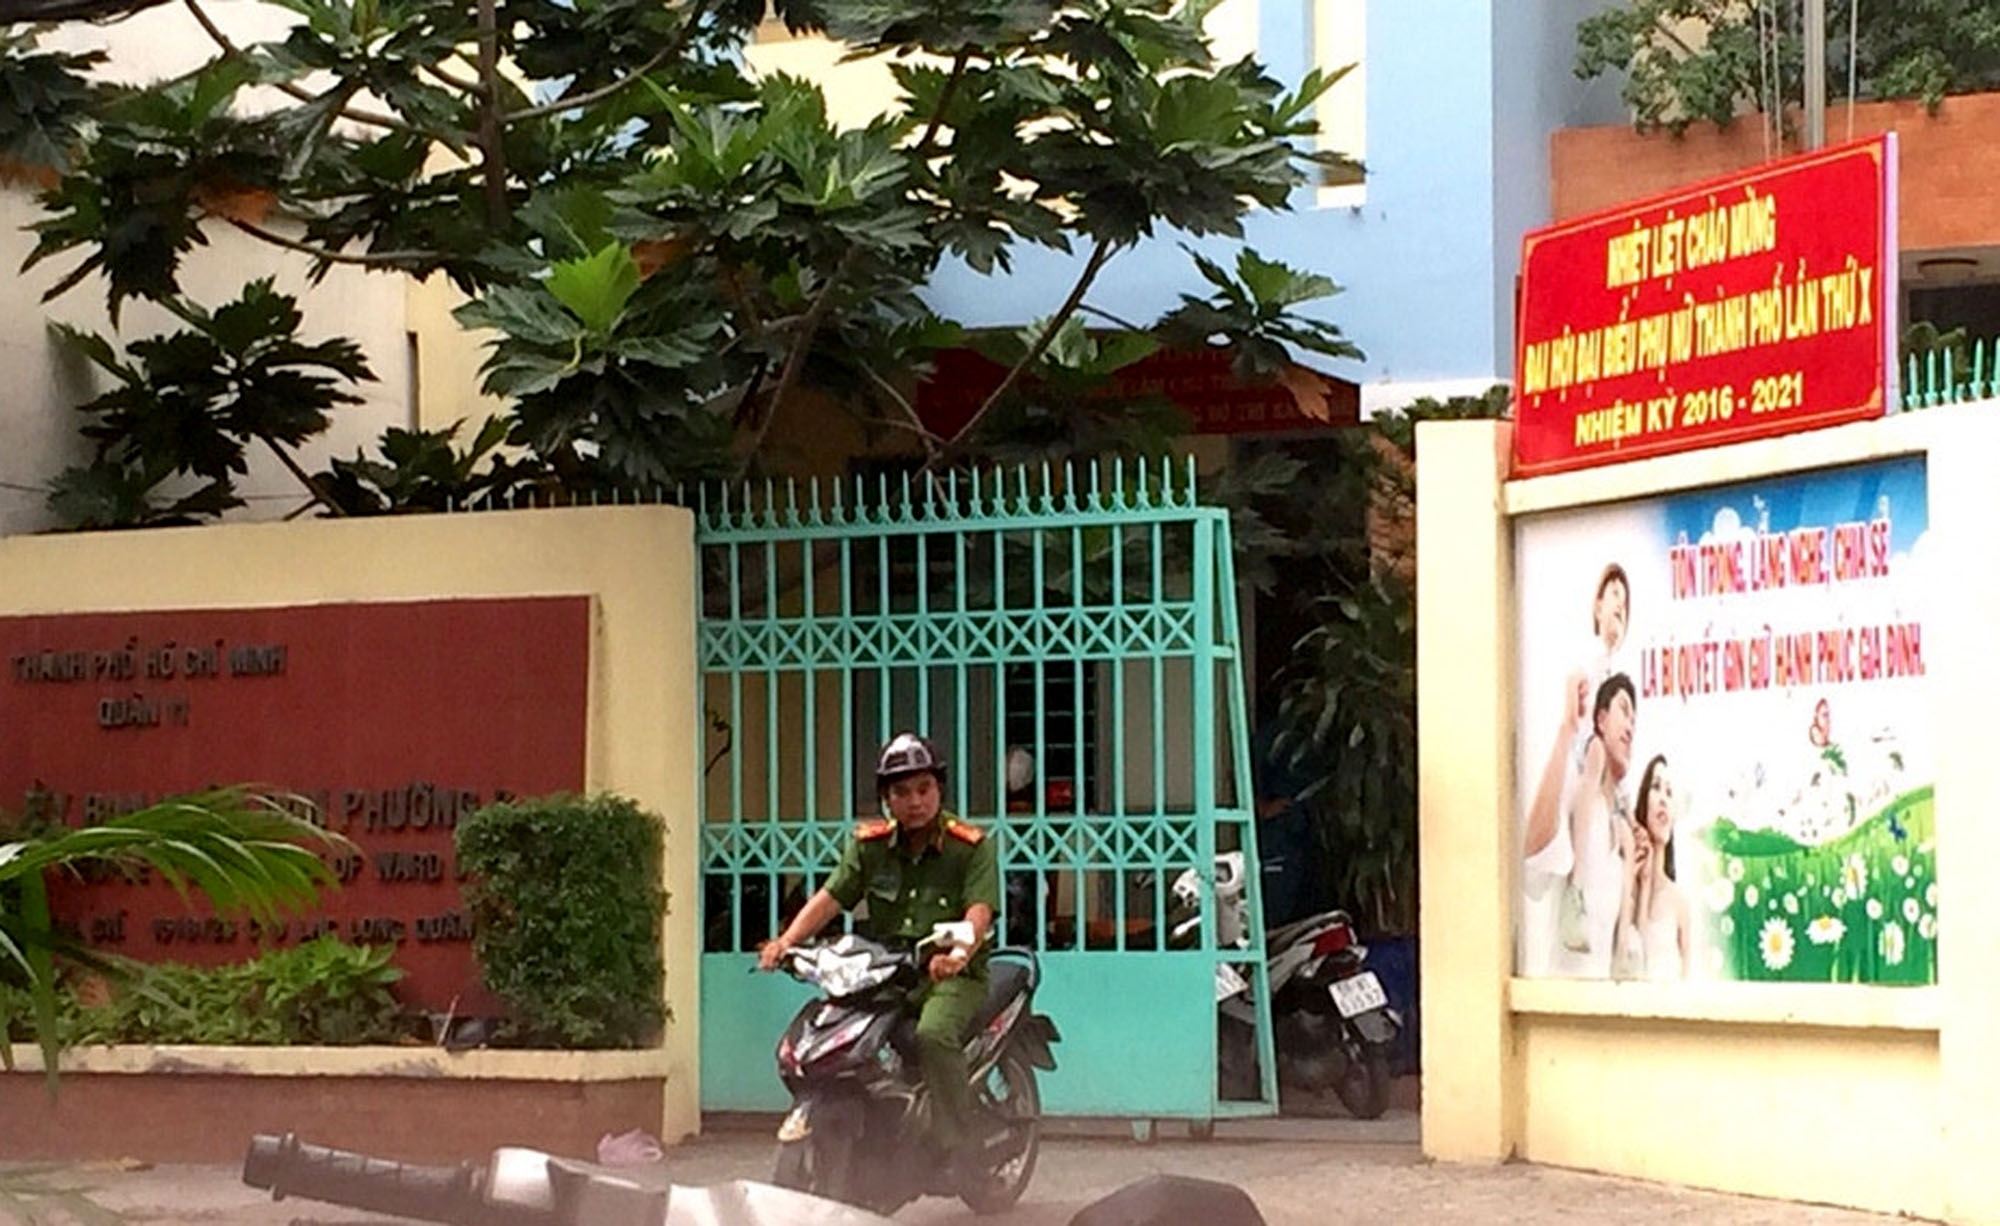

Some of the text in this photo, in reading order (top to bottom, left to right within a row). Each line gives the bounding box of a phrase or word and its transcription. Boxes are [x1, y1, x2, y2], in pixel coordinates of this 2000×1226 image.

[1607, 184, 1776, 299] NHIỆT LIỆT CHÀO MỪNG
[1525, 253, 1873, 408] ĐẠI HỘI ĐẠI BIỂU PHỤ NỮ THÀNH PHỐ LẦN THỨ X
[1575, 399, 1643, 449] NHIỆM
[1682, 384, 1734, 428] 2016
[1751, 370, 1804, 414] 2021
[1671, 532, 1698, 601] TÔN
[1834, 524, 1867, 581] CHIA
[228, 643, 288, 679] MINH
[1642, 634, 1658, 699] LÀ
[1661, 633, 1675, 697] BÍ
[1677, 621, 1720, 704] QUYẾT
[1775, 632, 1813, 699] HẠNH
[1817, 612, 1854, 684] PHÚC
[1859, 625, 1883, 681] GIA
